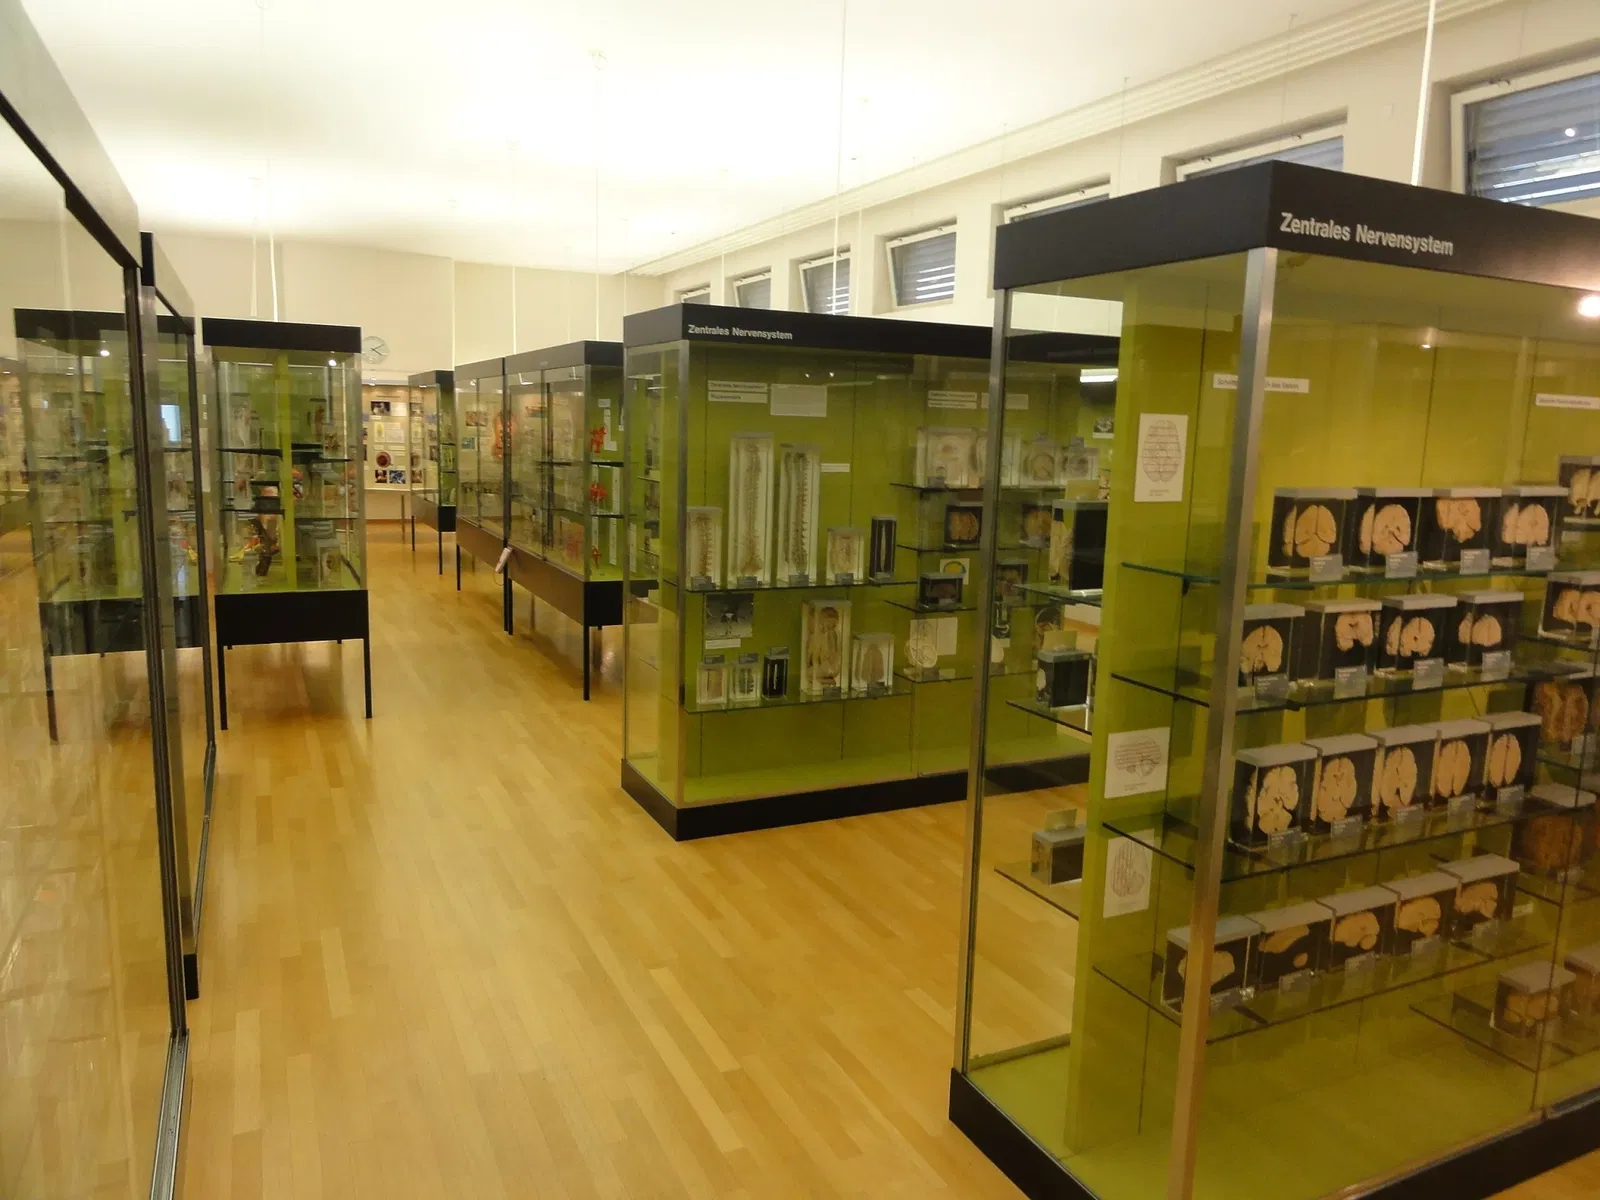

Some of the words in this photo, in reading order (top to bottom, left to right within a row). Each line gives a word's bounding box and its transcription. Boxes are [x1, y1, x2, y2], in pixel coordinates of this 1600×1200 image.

[1280, 212, 1351, 241] Zentrales
[1355, 224, 1453, 256] Nervensystem
[688, 324, 730, 336] Zentrales
[732, 327, 793, 340] Nervensystem
